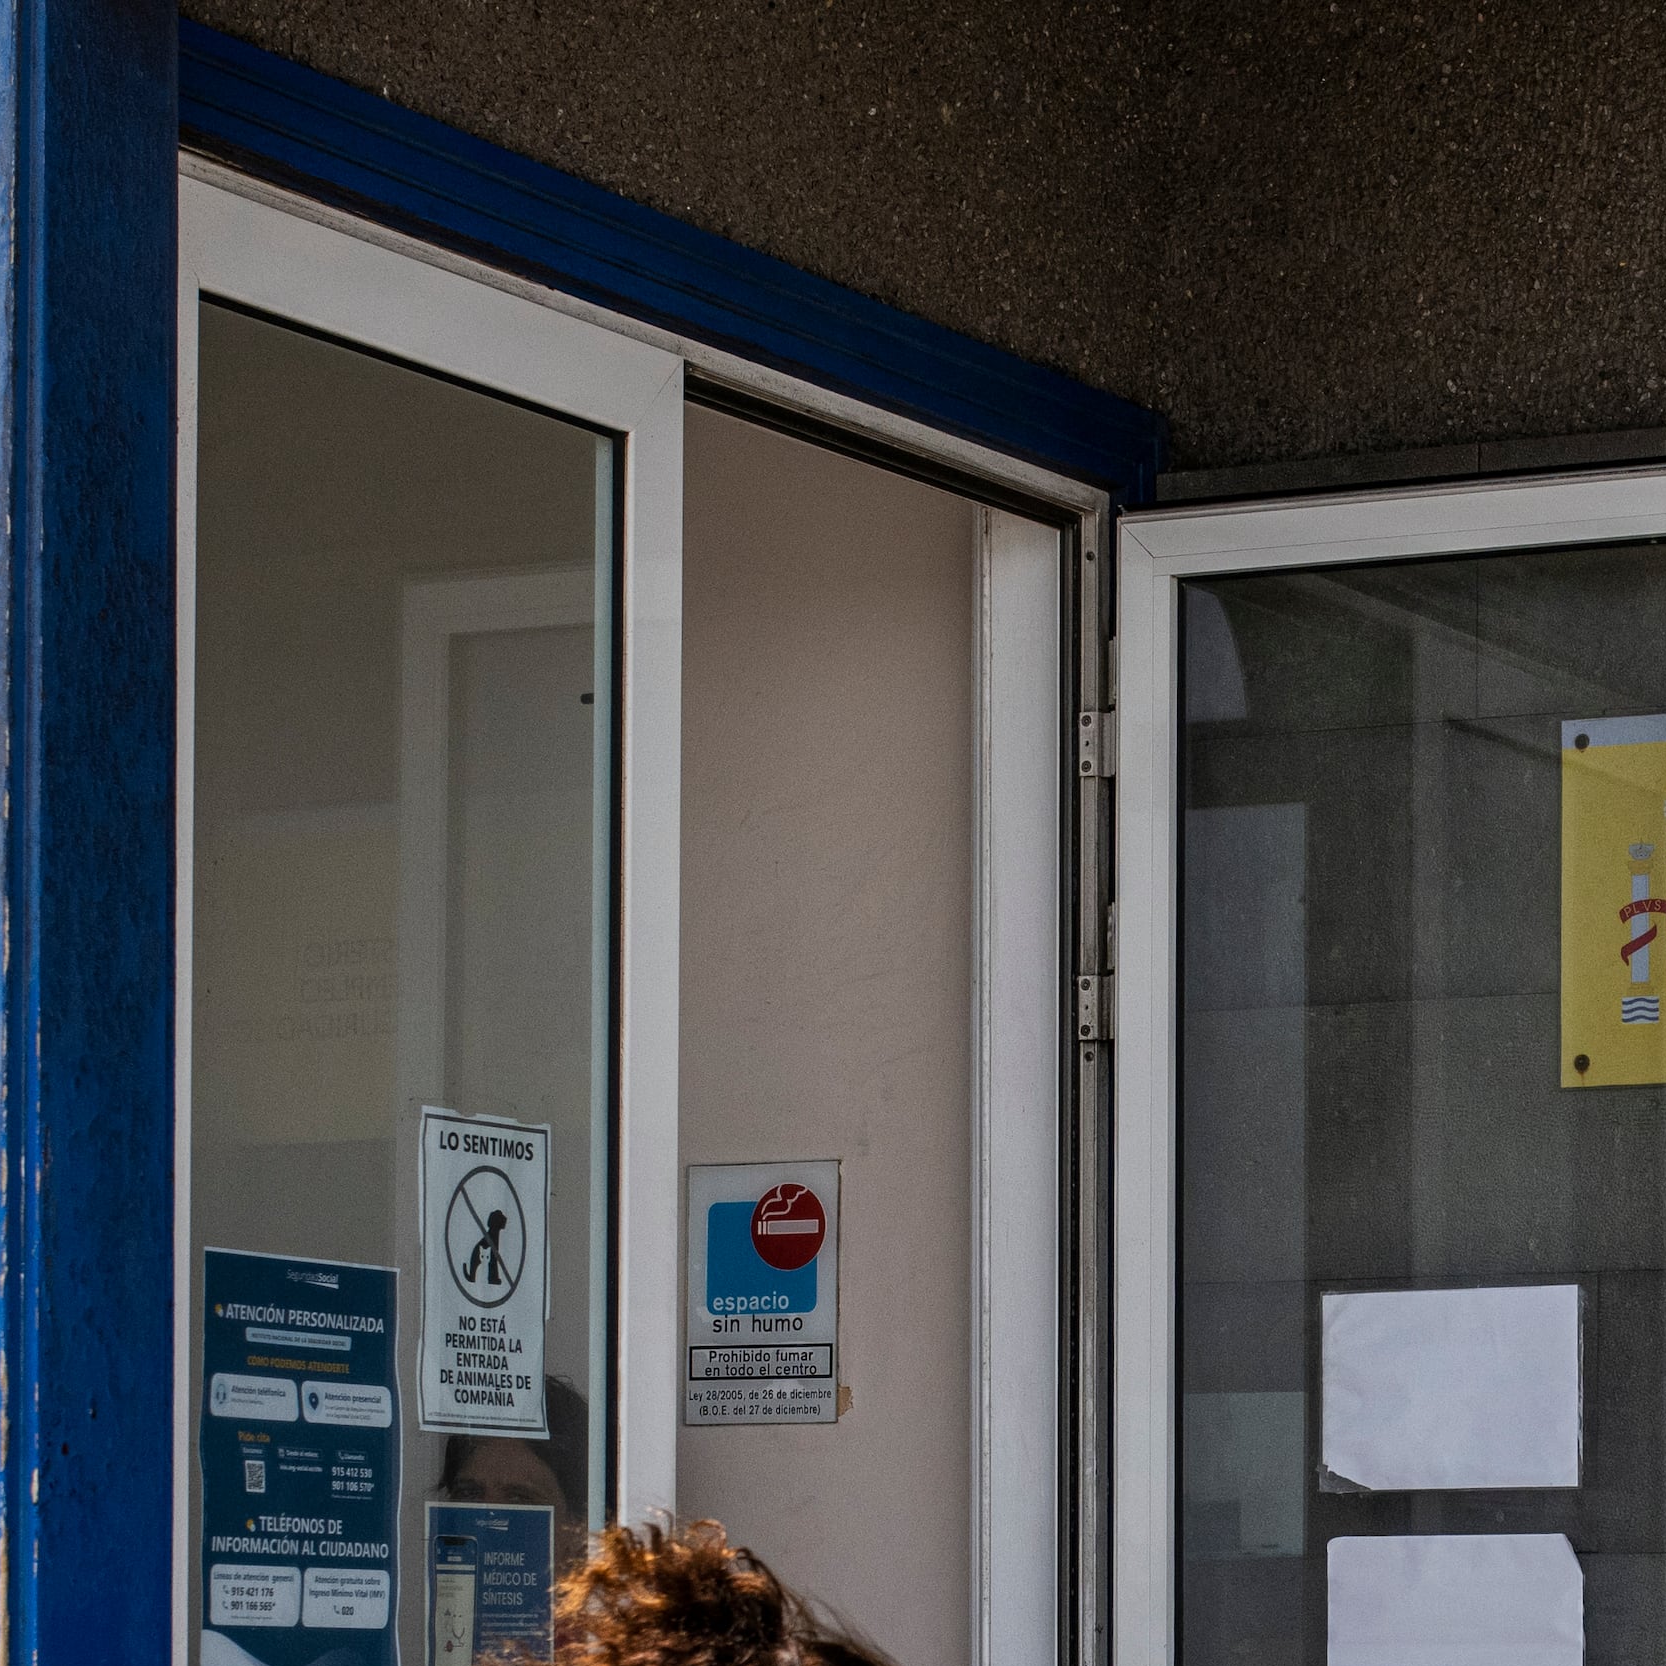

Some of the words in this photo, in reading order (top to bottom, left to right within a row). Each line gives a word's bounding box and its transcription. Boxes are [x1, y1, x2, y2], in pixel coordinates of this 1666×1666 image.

[440, 1131, 459, 1149] LO
[464, 1133, 534, 1161] SENTIMOS
[713, 1291, 789, 1314] espacio
[226, 1303, 284, 1325] ATENCIÓN
[288, 1310, 384, 1334] PERSONALIZADA
[459, 1315, 477, 1331] NO
[480, 1315, 506, 1334] ESTÁ
[713, 1314, 740, 1333] sin
[752, 1315, 803, 1332] humo
[445, 1333, 505, 1353] PERMITIDA
[509, 1339, 523, 1354] LA
[456, 1353, 509, 1371] ENTRADA
[709, 1349, 770, 1363] Prohibido
[776, 1349, 813, 1362] fumar
[705, 1366, 720, 1376] en
[725, 1364, 754, 1376] todo
[759, 1363, 770, 1375] el
[776, 1364, 817, 1375] centro
[440, 1369, 454, 1384] DE
[456, 1371, 513, 1389] ANIMALES
[516, 1375, 531, 1390] DE
[689, 1390, 703, 1402] Ley
[749, 1390, 759, 1400] de
[763, 1390, 773, 1400] 26
[777, 1389, 787, 1399] de
[790, 1389, 832, 1399] diciembre
[699, 1406, 730, 1417] (B.O.E.
[733, 1405, 745, 1415] del
[749, 1405, 760, 1415] 27
[763, 1405, 773, 1415] de
[776, 1404, 821, 1417] diciembre)
[332, 1467, 345, 1476] 915
[346, 1467, 358, 1477] 412
[332, 1481, 344, 1490] 901
[346, 1482, 358, 1491] 106
[259, 1513, 324, 1534] TELÉFONOS
[328, 1520, 343, 1534] DE
[212, 1535, 299, 1555] INFORMACIÓN
[302, 1541, 316, 1556] AL
[319, 1541, 389, 1558] CIUDADANO
[484, 1552, 525, 1566] INFORME
[233, 1572, 241, 1581] de
[272, 1574, 294, 1584] general
[340, 1576, 362, 1587] gratuita
[364, 1577, 381, 1586] sobre
[484, 1569, 520, 1585] MÉDICO
[524, 1573, 537, 1586] DE
[231, 1587, 243, 1596] 915
[245, 1587, 258, 1596] 421
[260, 1588, 274, 1597] 176
[309, 1589, 330, 1600] Ingreso
[355, 1589, 368, 1599] Vital
[483, 1589, 523, 1605] SÍNTESIS
[231, 1601, 244, 1611] 901
[246, 1601, 258, 1611] 166
